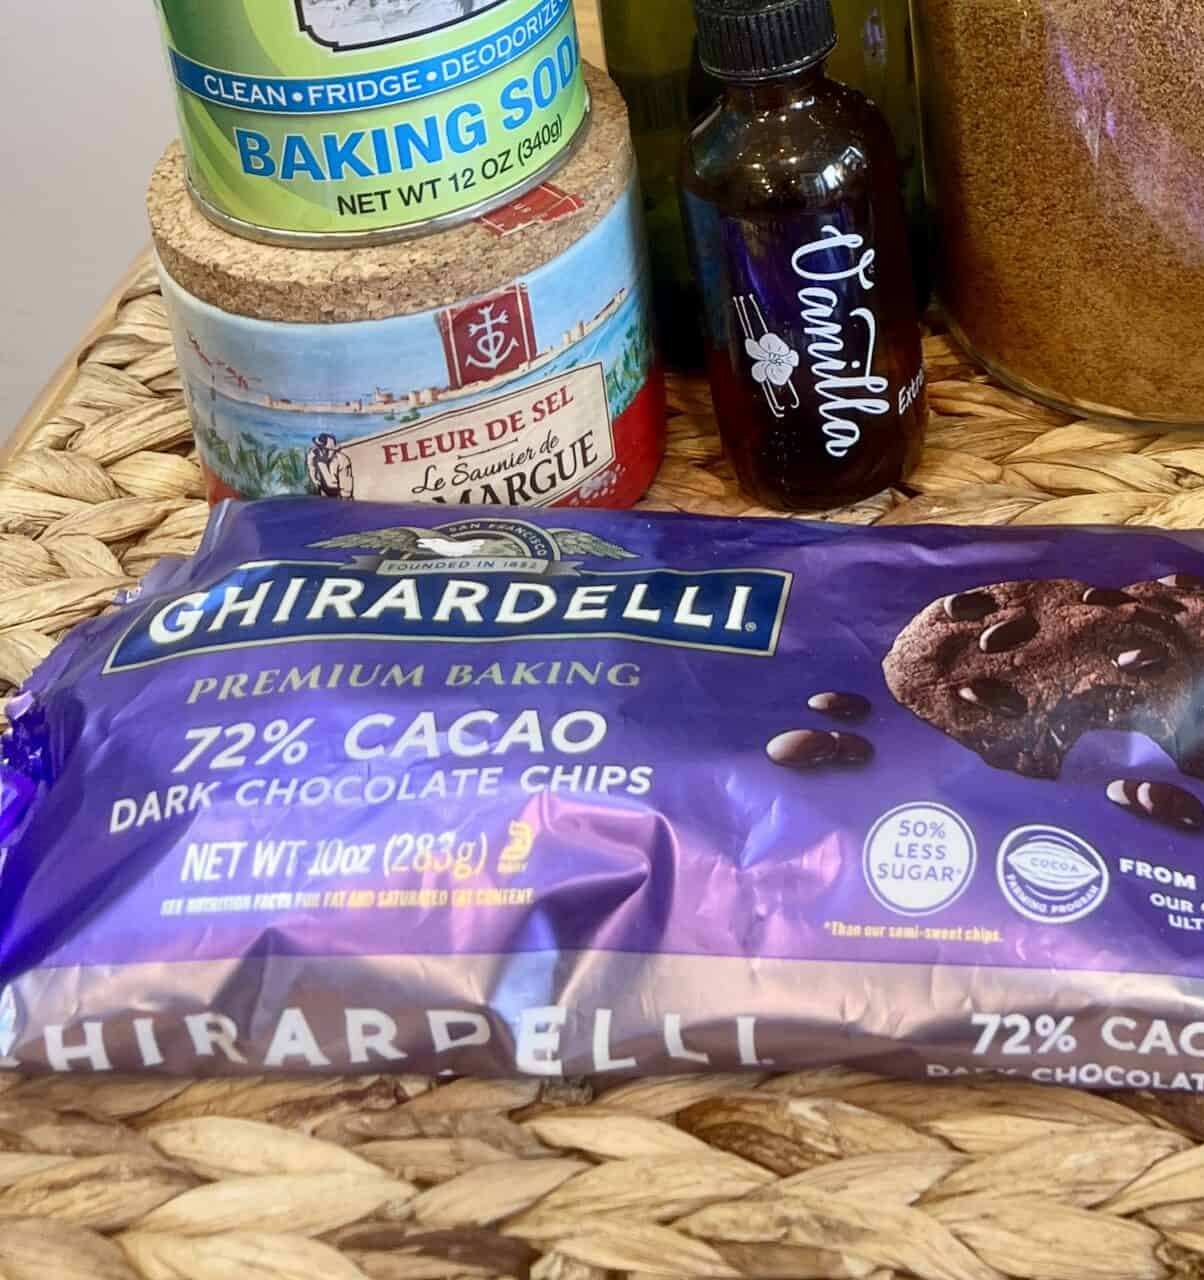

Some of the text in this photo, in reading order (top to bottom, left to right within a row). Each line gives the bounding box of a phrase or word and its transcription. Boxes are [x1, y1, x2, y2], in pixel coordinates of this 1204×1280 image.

[204, 74, 287, 108] CLEAN
[309, 69, 419, 106] FRIDGE
[233, 34, 579, 183] BAKING SOD
[337, 117, 563, 217] NET WT 12 OZ (340g)
[792, 224, 890, 458] Vanilla
[382, 385, 575, 465] FLEUR DE SEL
[411, 429, 561, 495] Le Saunier de
[447, 521, 548, 558] SAN FRANCISCO
[387, 560, 472, 570] FOUNDED
[476, 559, 495, 570] IN
[148, 577, 748, 645] GHIRARDELLI
[187, 660, 641, 704] PREMIUM BAKING
[172, 709, 608, 774] 72% CACAO
[109, 764, 653, 835] DARK CHOCOLATE CHIPS
[893, 841, 947, 861] LESS
[898, 819, 947, 840] 50%
[180, 831, 488, 883] NET WT 10oz (283g)
[1030, 857, 1080, 873] COCOA
[1119, 857, 1197, 891] FROM
[1150, 892, 1194, 914] OUR
[864, 925, 886, 937] our
[889, 924, 962, 942] semi-sweet
[0, 996, 768, 1077] HIRARDELLI
[970, 1013, 1078, 1057] 72%
